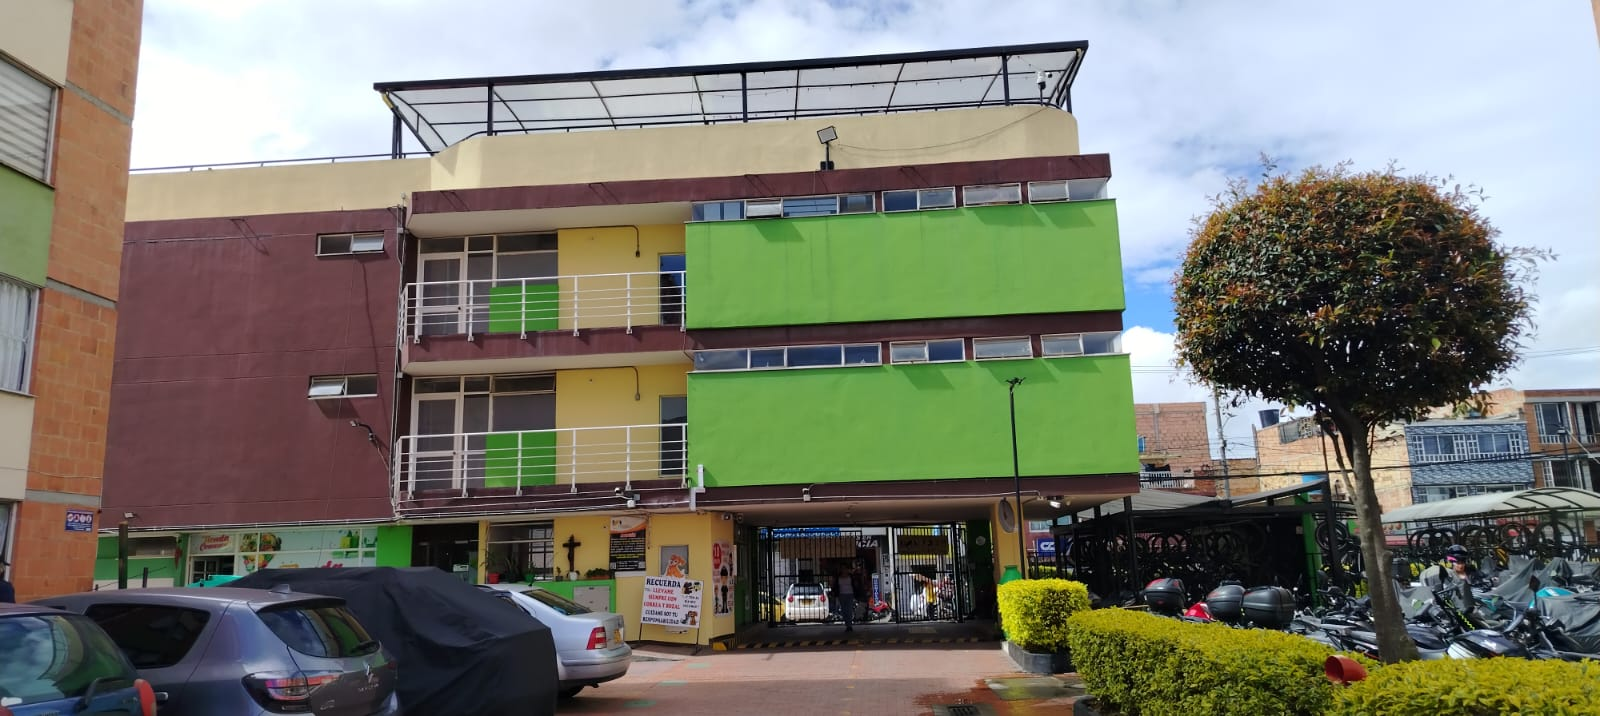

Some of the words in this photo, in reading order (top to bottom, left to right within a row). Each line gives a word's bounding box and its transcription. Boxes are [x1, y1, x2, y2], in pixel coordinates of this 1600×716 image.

[646, 578, 681, 588] RECUERDA
[652, 587, 674, 595] LLEVAME
[642, 616, 680, 625] RESPONSABILIDAD
